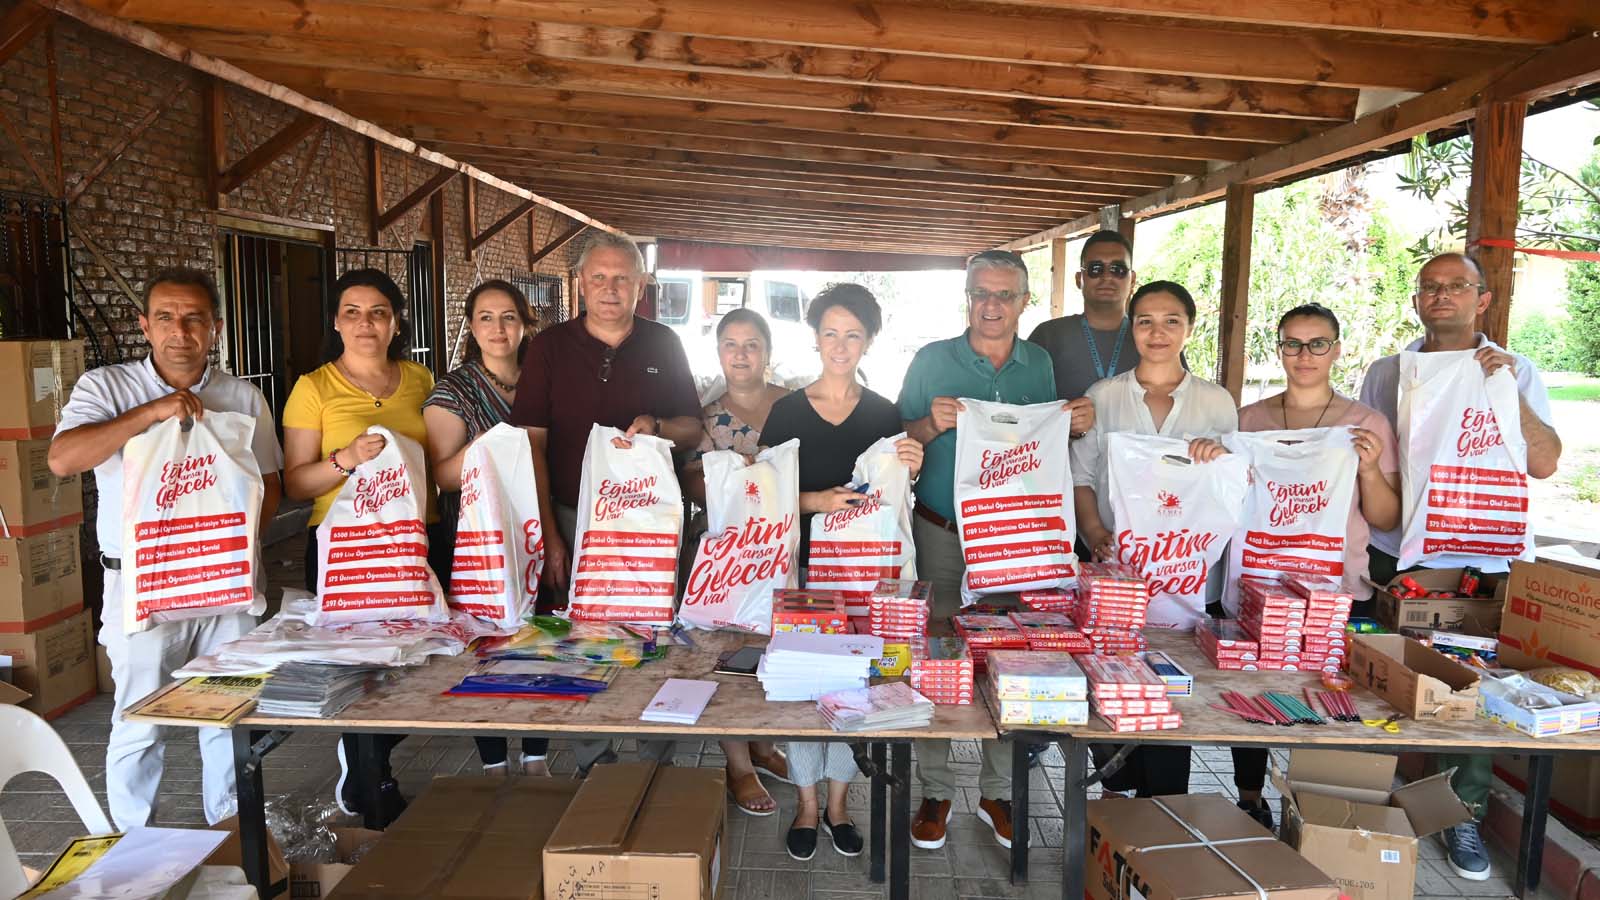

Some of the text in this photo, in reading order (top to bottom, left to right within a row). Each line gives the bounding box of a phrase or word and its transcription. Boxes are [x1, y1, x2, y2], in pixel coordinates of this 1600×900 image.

[1457, 429, 1505, 458] Gelec
[979, 453, 1042, 490] Gelecek
[599, 475, 658, 499] Eğitim
[1267, 479, 1328, 503] Eğitim
[595, 490, 660, 522] Gelecek
[977, 503, 995, 511] İlkokul
[995, 501, 1024, 510] Öğrencisine
[1269, 495, 1330, 528] Gelecek
[1503, 500, 1521, 508] Servisi
[966, 528, 978, 536] 1789
[989, 524, 1018, 534] Öğrencisine
[186, 546, 201, 554] Okul
[201, 544, 220, 552] Servisi
[977, 550, 1002, 559] Üniversite
[1002, 548, 1032, 558] Öğrencisine
[1032, 546, 1048, 555] Eğitim
[1118, 528, 1219, 575] Eğitim
[202, 571, 220, 580] Eğitim
[685, 543, 791, 606] Gelecek
[1156, 559, 1200, 577] varsa
[1526, 577, 1541, 592] La
